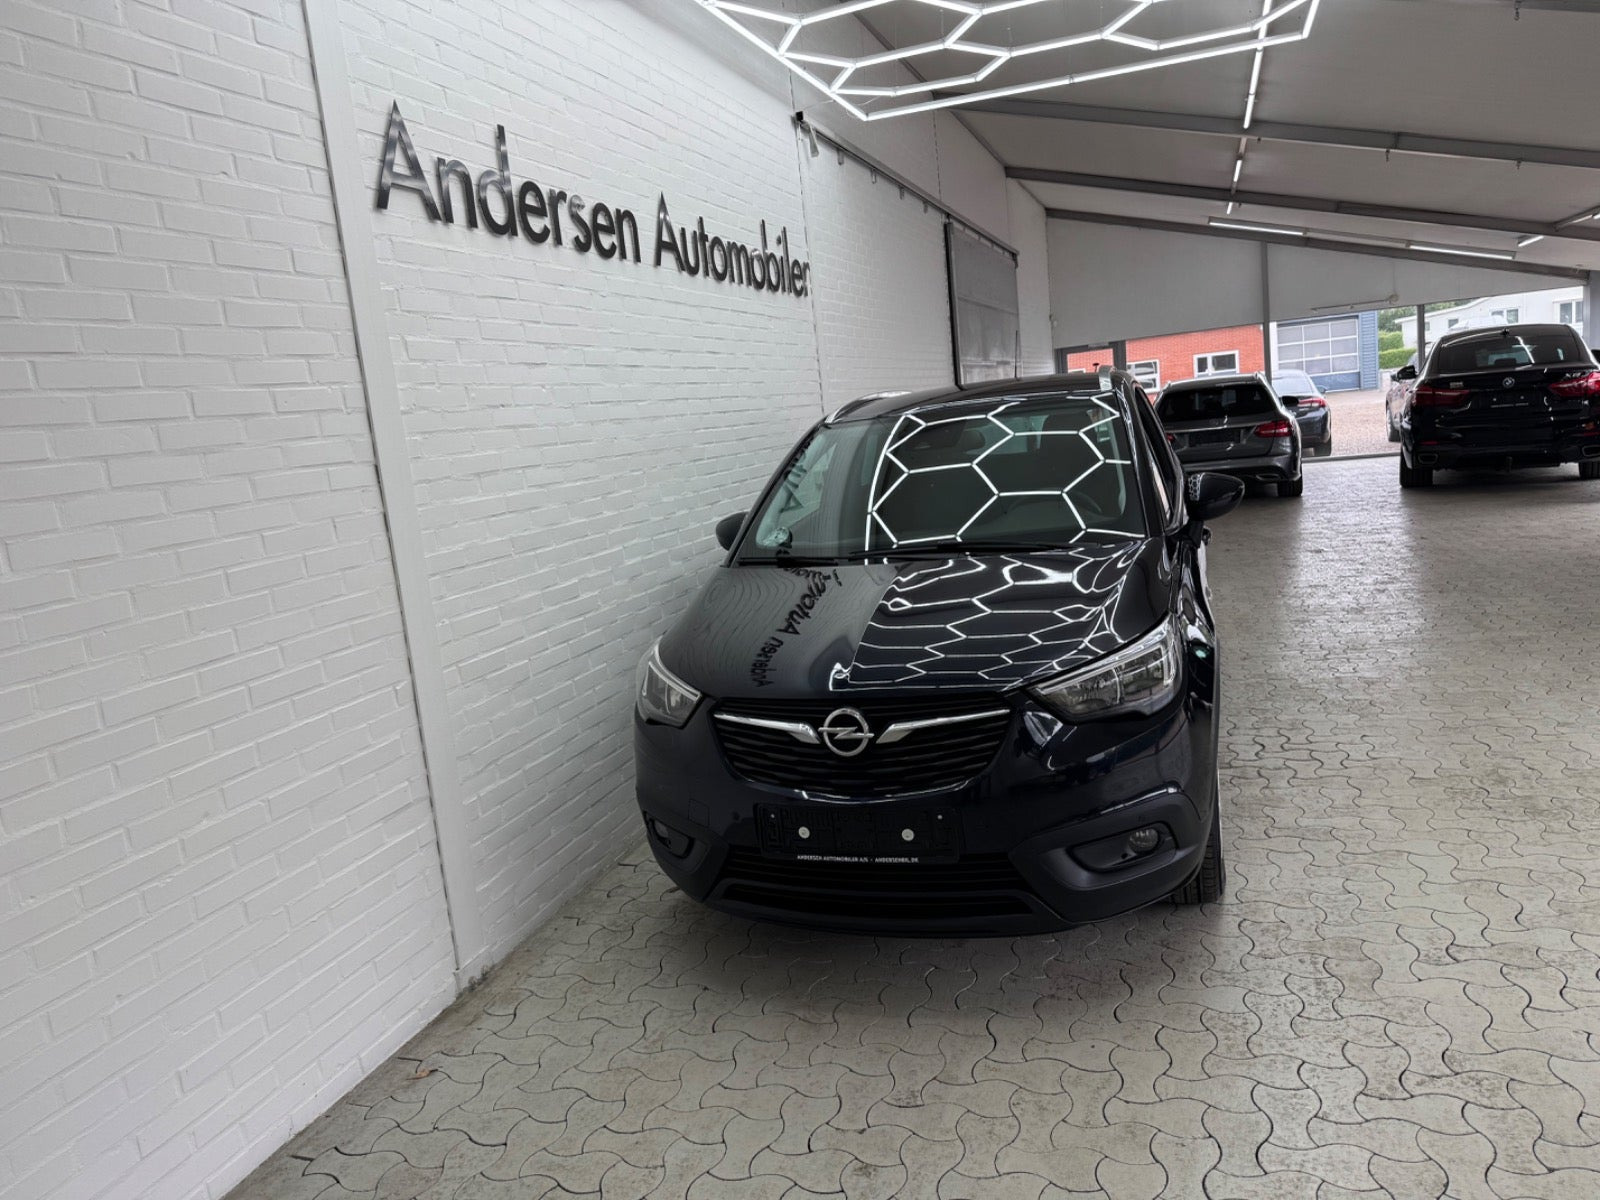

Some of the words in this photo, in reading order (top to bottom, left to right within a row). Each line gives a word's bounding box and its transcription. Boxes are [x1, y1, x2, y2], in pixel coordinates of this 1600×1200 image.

[375, 99, 641, 263] Andersen
[656, 191, 810, 297] Automobiler
[823, 855, 859, 863] AUTOMOBILER
